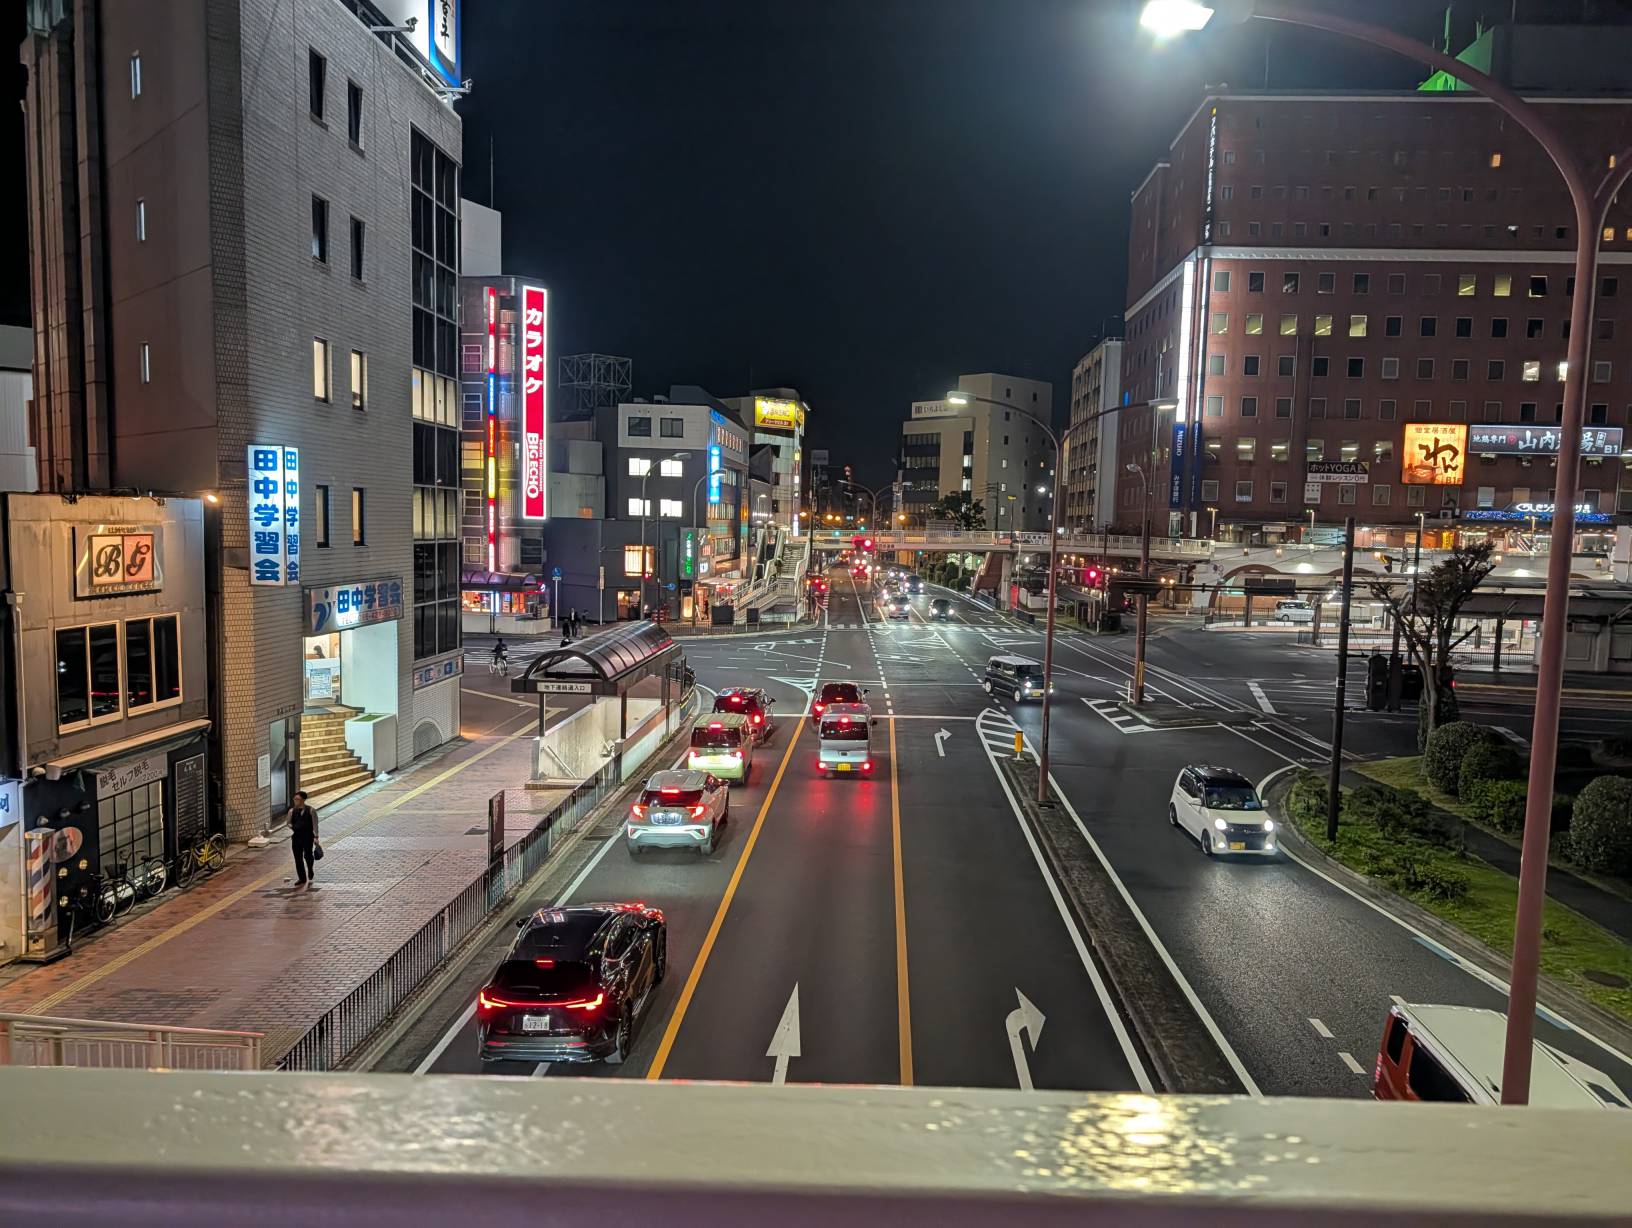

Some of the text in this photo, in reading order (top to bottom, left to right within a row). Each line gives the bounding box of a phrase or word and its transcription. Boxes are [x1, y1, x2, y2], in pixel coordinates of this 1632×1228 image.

[525, 308, 543, 394] カラオケ
[1418, 436, 1460, 473] わん
[1518, 430, 1595, 451] 山内場
[1604, 445, 1619, 453] B1
[526, 432, 540, 499] BIG ECHO
[253, 449, 281, 582] 田中学習会
[285, 450, 299, 582] 田中学習会
[337, 582, 400, 613] 田中学習会
[112, 759, 150, 792] セルフ脱毛
